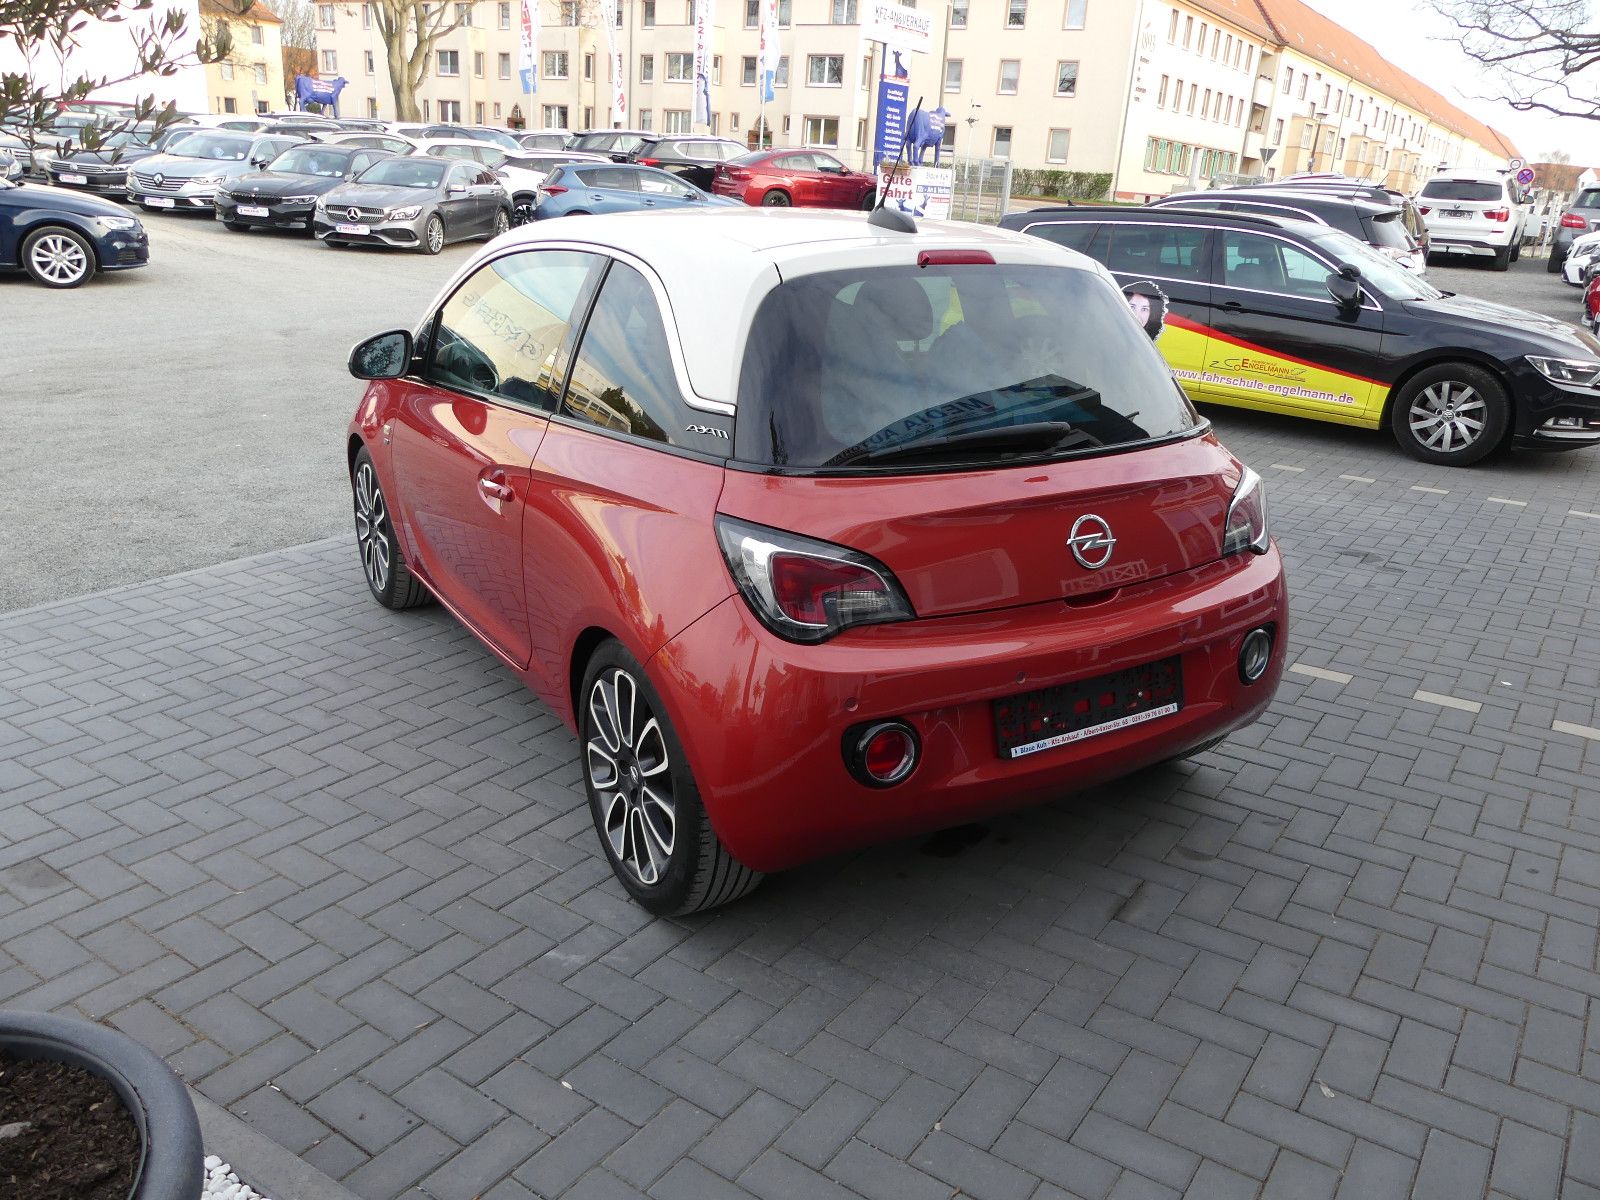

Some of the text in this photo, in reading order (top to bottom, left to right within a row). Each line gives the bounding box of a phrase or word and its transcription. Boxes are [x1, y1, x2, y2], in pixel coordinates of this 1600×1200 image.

[883, 174, 912, 186] Gute
[880, 187, 912, 199] Fahrt
[1242, 358, 1290, 375] ENGELMANN
